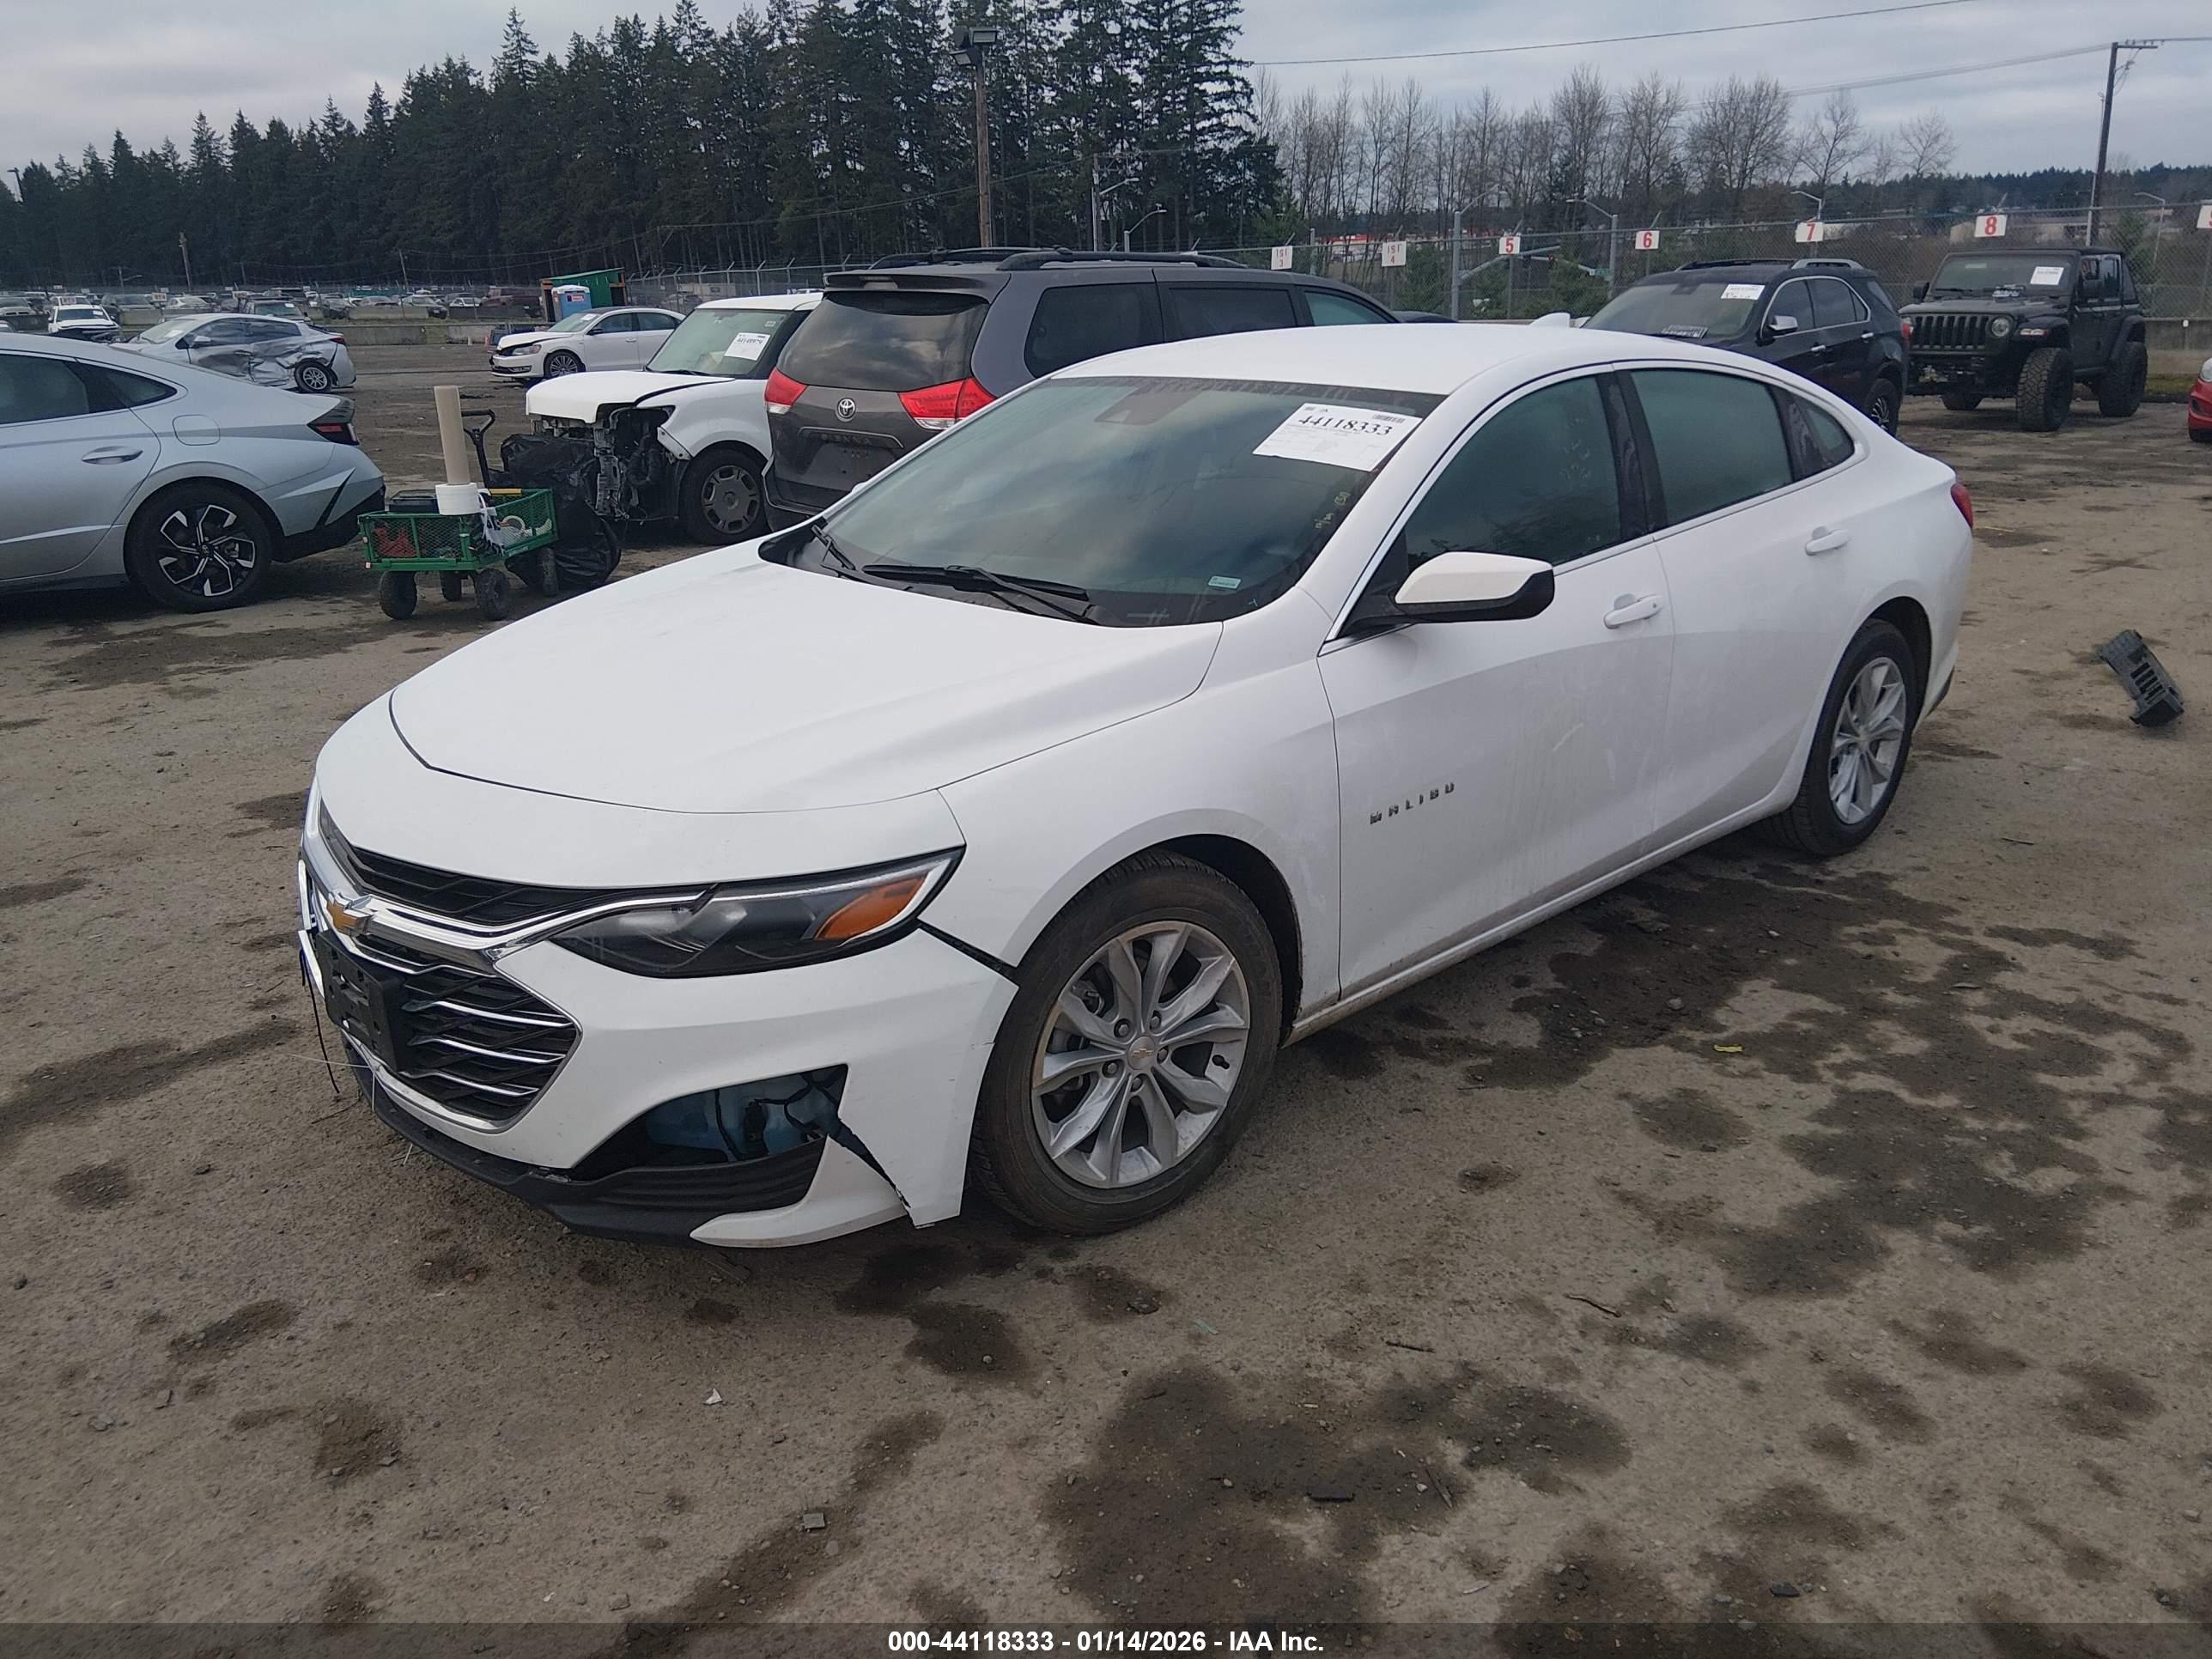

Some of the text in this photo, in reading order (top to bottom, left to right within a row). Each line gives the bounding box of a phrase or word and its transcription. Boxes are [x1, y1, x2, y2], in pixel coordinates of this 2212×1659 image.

[1806, 222, 1816, 241] 7
[1984, 216, 1997, 235] 8
[1505, 237, 1514, 253] 5
[1642, 232, 1652, 248] 6
[1298, 416, 1393, 435] 44118333
[1370, 781, 1455, 825] MALIBU
